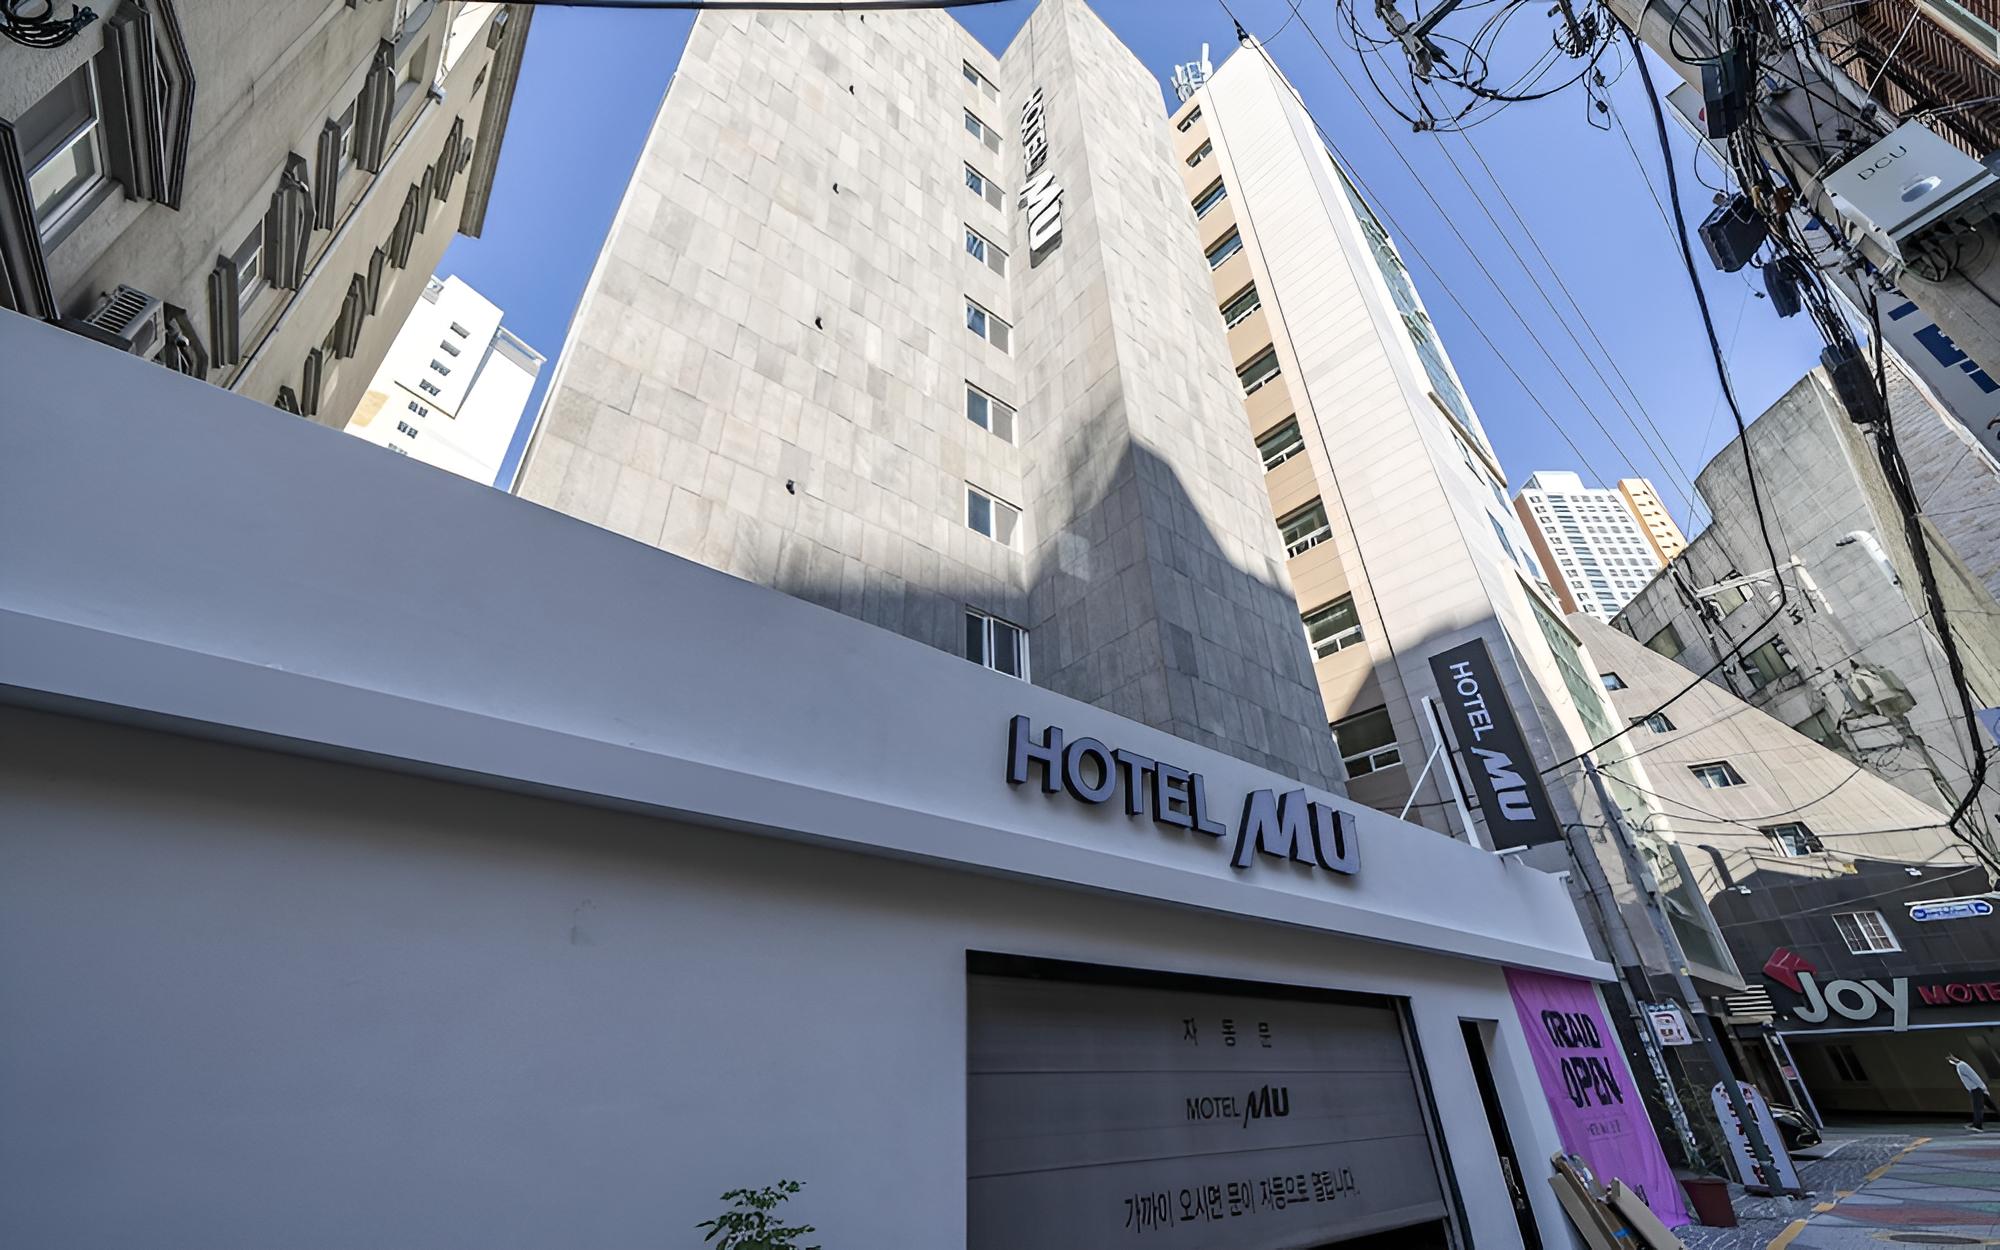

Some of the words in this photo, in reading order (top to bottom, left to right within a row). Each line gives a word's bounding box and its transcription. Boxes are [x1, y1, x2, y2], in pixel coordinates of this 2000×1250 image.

[1021, 86, 1048, 183] HOTEL
[1857, 145, 1908, 181] DCU
[1017, 169, 1064, 268] MU
[1450, 661, 1494, 742] HOTEL
[1006, 714, 1226, 837] HOTEL
[1230, 788, 1361, 875] MU
[1471, 746, 1537, 821] MU
[1793, 971, 1909, 1032] JOY
[1186, 1096, 1240, 1120] MOTEL
[1243, 1084, 1290, 1128] MU
[1560, 1056, 1624, 1108] OPEN
[1125, 1189, 1174, 1233] 가까이
[1179, 1184, 1223, 1222] 오시면
[1227, 1178, 1256, 1214] 문이
[1260, 1173, 1310, 1211] 자동으로
